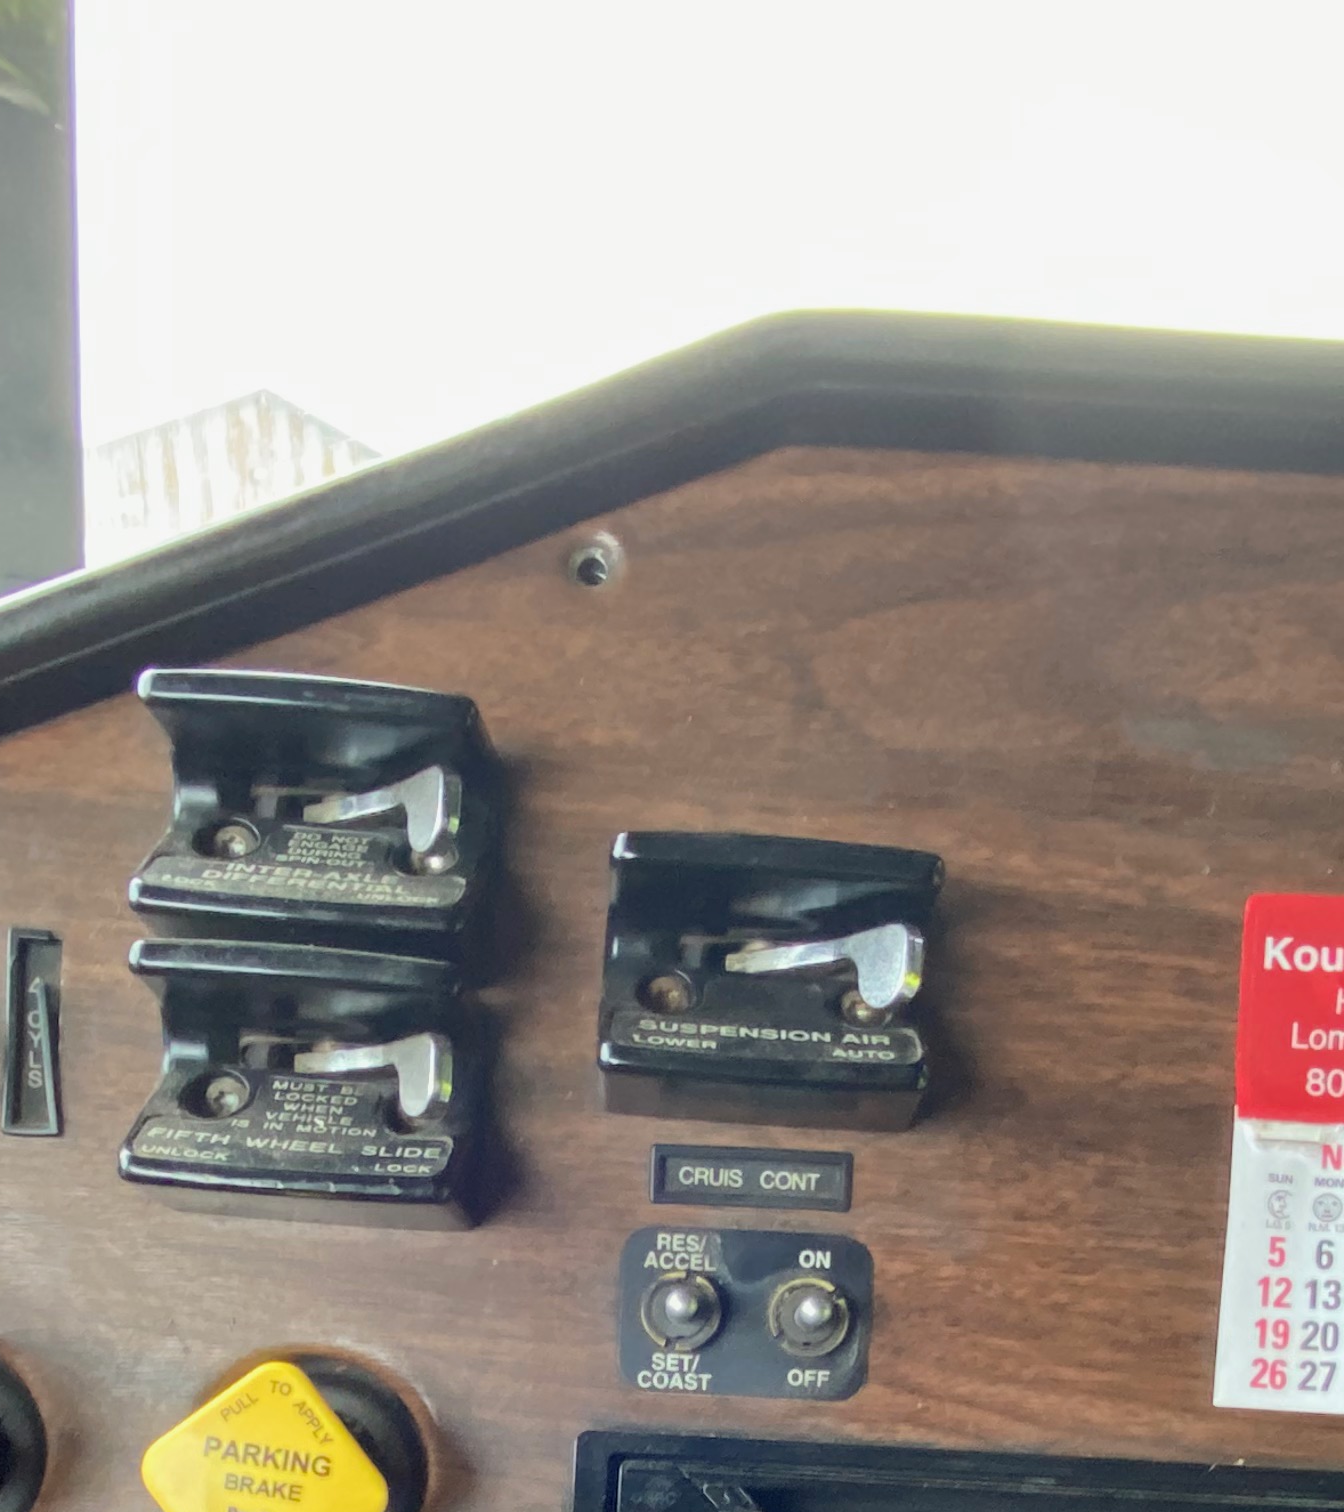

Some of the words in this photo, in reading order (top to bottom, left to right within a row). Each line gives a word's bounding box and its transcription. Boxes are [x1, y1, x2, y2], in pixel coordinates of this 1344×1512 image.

[288, 840, 369, 853] ENGAGE
[294, 831, 322, 841] DO
[331, 835, 370, 845] NOT
[275, 854, 367, 868] SPIN-OUT
[287, 847, 362, 859] DURING
[161, 874, 217, 889] LOCK
[202, 870, 409, 894] DIFFERENTIAL
[226, 862, 400, 885] INTER-AXLE
[357, 892, 441, 904] UNLOCK
[633, 1033, 717, 1050] LOWER
[638, 1019, 831, 1044] SUSPENSION
[842, 1031, 891, 1046] AIR
[832, 1047, 895, 1060] AUTO
[272, 1080, 330, 1093] MUST
[341, 1083, 362, 1096] B
[274, 1091, 358, 1106] LOCKED
[283, 1102, 344, 1115] WHEN
[231, 1118, 249, 1129] IS
[263, 1120, 284, 1132] IN
[296, 1123, 377, 1138] MOTION
[265, 1112, 353, 1127] VEHICLE
[141, 1144, 229, 1162] UNLOCK
[147, 1126, 231, 1145] FIFTH
[245, 1136, 343, 1154] WHEEL
[361, 1145, 442, 1160] SLIDE
[374, 1162, 433, 1174] LOCK
[679, 1165, 743, 1188] CRUIS
[760, 1170, 821, 1191] CONT
[1268, 1173, 1294, 1185] SUN
[1314, 1176, 1344, 1189] MON
[657, 1233, 706, 1252] RES/
[644, 1251, 717, 1272] ACCEL
[798, 1250, 831, 1270] ON
[1268, 1236, 1287, 1269] 5
[1315, 1240, 1334, 1270] 6
[1257, 1276, 1292, 1309] 12
[1305, 1279, 1342, 1311] 13
[1255, 1318, 1290, 1351] 19
[1299, 1320, 1339, 1352] 20
[651, 1353, 700, 1373] SET/
[637, 1371, 712, 1391] COAST
[787, 1368, 831, 1388] OFF
[1249, 1358, 1287, 1391] 26
[1297, 1360, 1337, 1392] 27
[219, 1393, 260, 1422] PULL
[269, 1379, 293, 1397] TO
[292, 1399, 334, 1446] APPLY
[203, 1436, 332, 1478] PARKING
[224, 1472, 304, 1503] BRAKE
